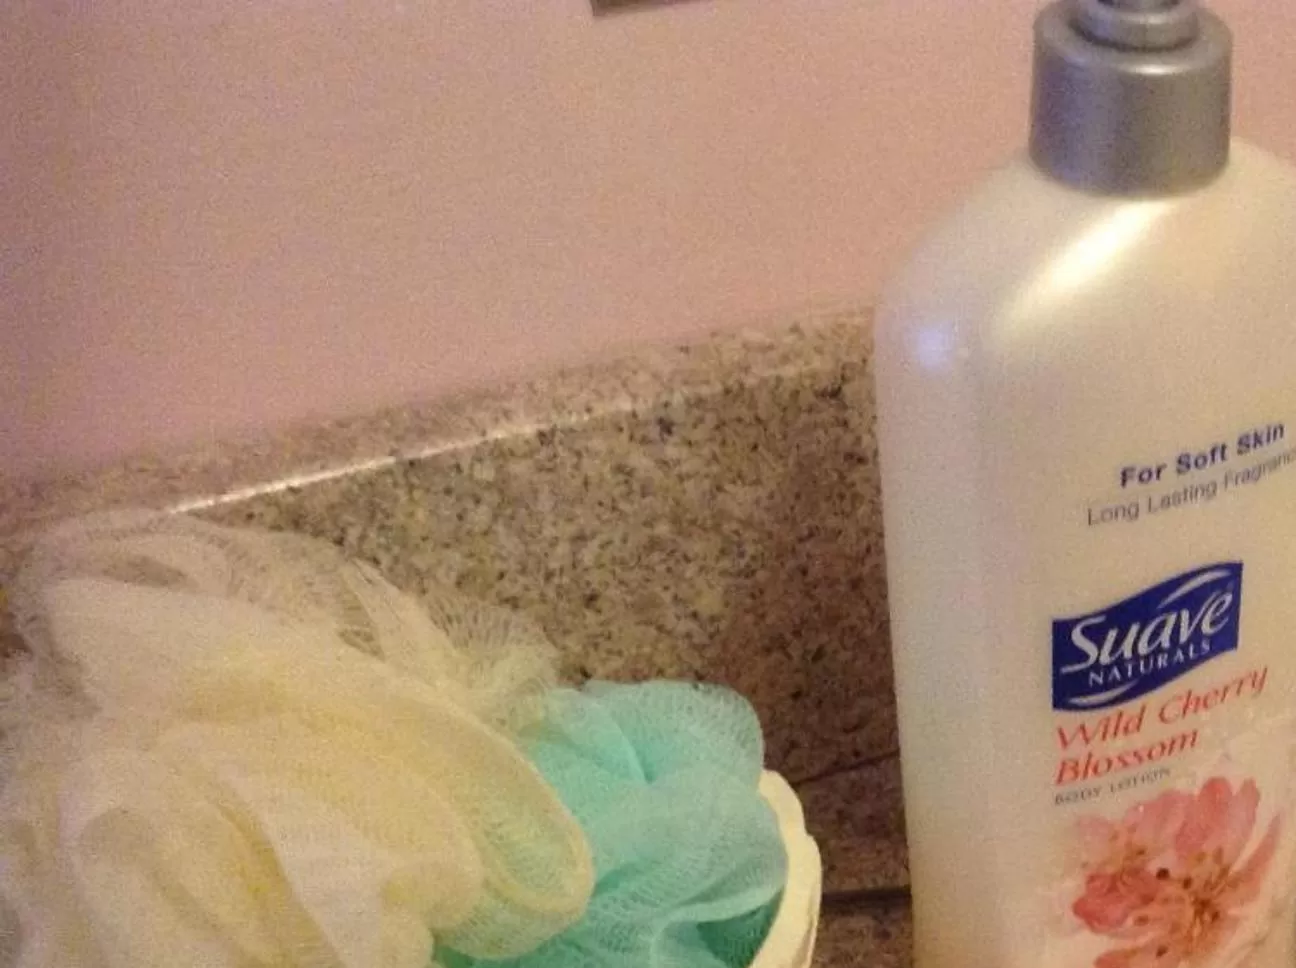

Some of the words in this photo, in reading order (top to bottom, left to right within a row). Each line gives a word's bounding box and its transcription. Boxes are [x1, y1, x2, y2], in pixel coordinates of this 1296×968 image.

[1119, 463, 1168, 489] For
[1175, 443, 1227, 475] Soft
[1236, 423, 1286, 456] Skin
[1086, 502, 1140, 526] Long
[1148, 480, 1218, 514] Lasting
[1061, 589, 1234, 674] Suave
[1089, 638, 1214, 687] NATURALS
[1056, 703, 1147, 749] Wild
[1158, 664, 1268, 725] Cherry
[1055, 728, 1199, 786] Blossom
